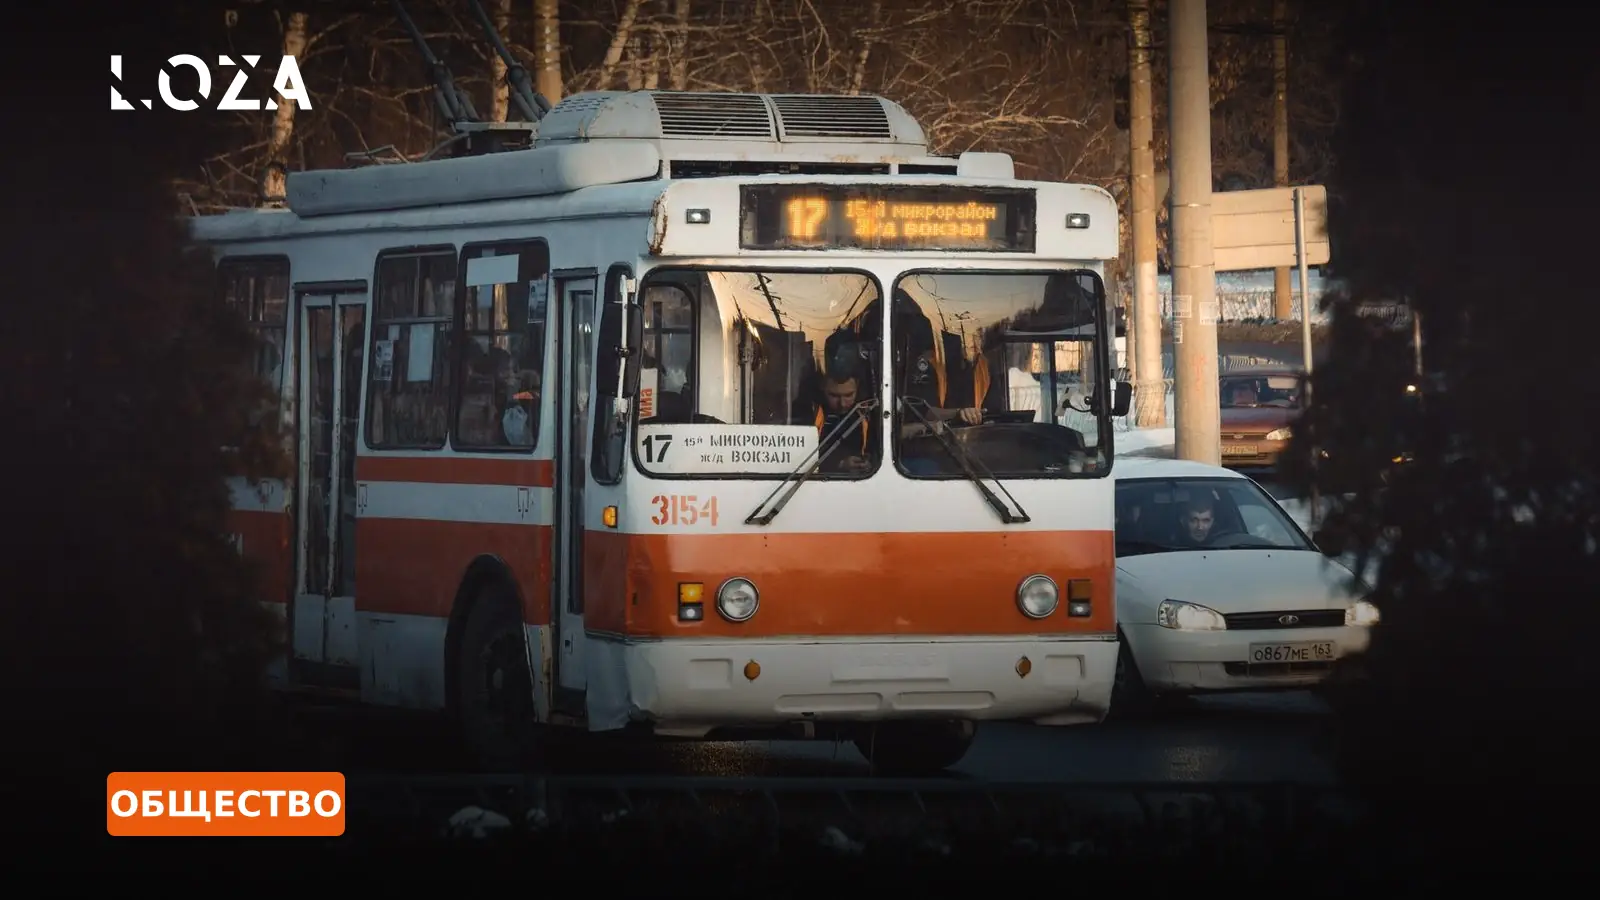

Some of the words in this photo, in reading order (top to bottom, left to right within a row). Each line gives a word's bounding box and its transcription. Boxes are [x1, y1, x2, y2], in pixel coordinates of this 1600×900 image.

[787, 198, 828, 237] 17
[641, 434, 673, 463] 17
[710, 432, 805, 448] МИКРОРАЙОН
[731, 450, 791, 464] ВОКЗАЛ
[651, 495, 719, 527] 3154
